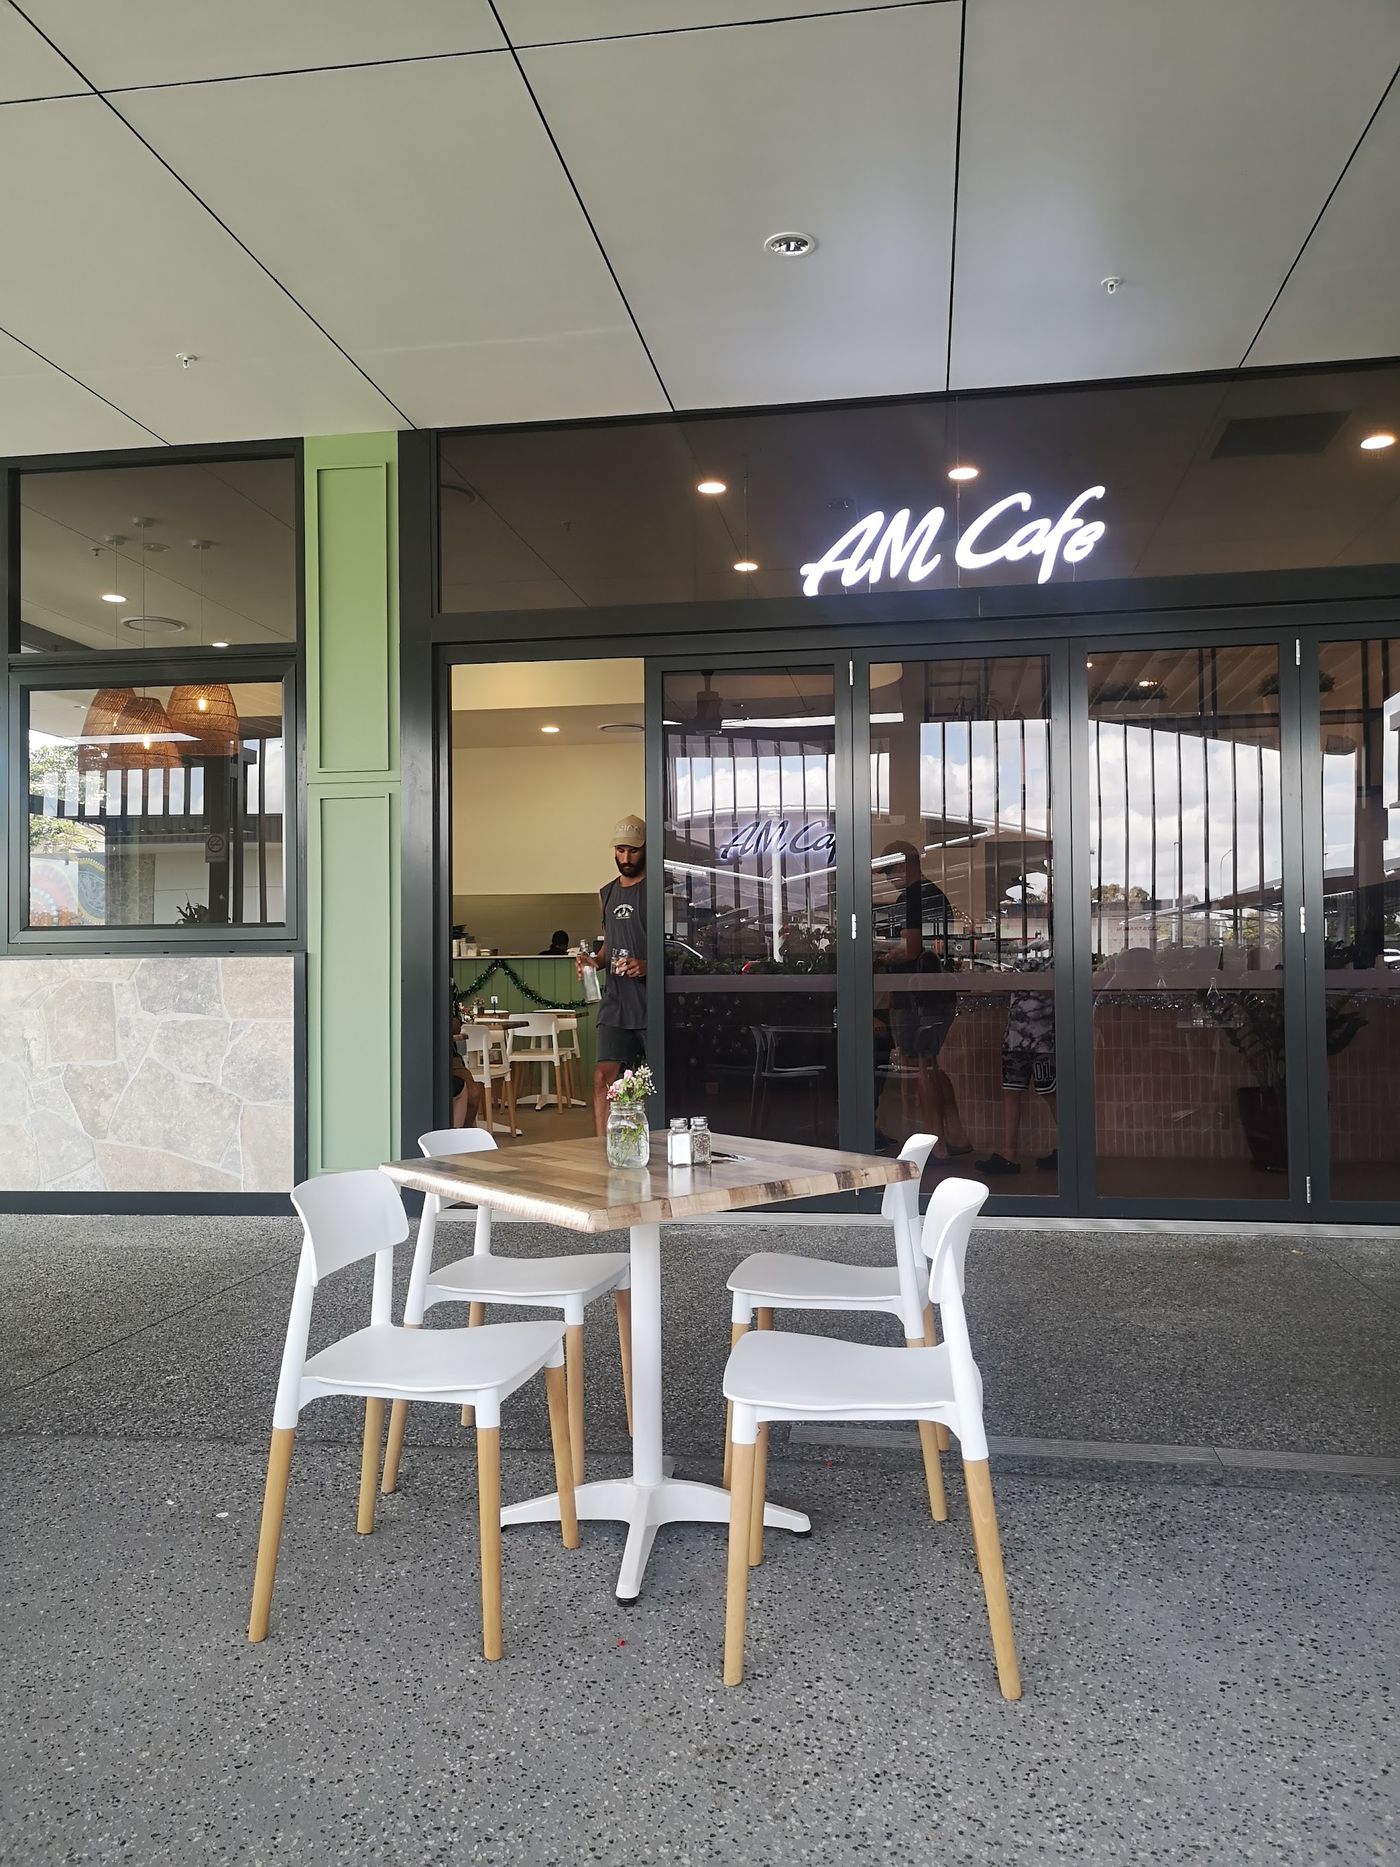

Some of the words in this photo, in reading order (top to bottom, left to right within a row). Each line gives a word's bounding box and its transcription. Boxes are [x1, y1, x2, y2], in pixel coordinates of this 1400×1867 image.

[800, 506, 945, 597] AM
[955, 486, 1106, 585] Cafe
[719, 819, 789, 859] AM
